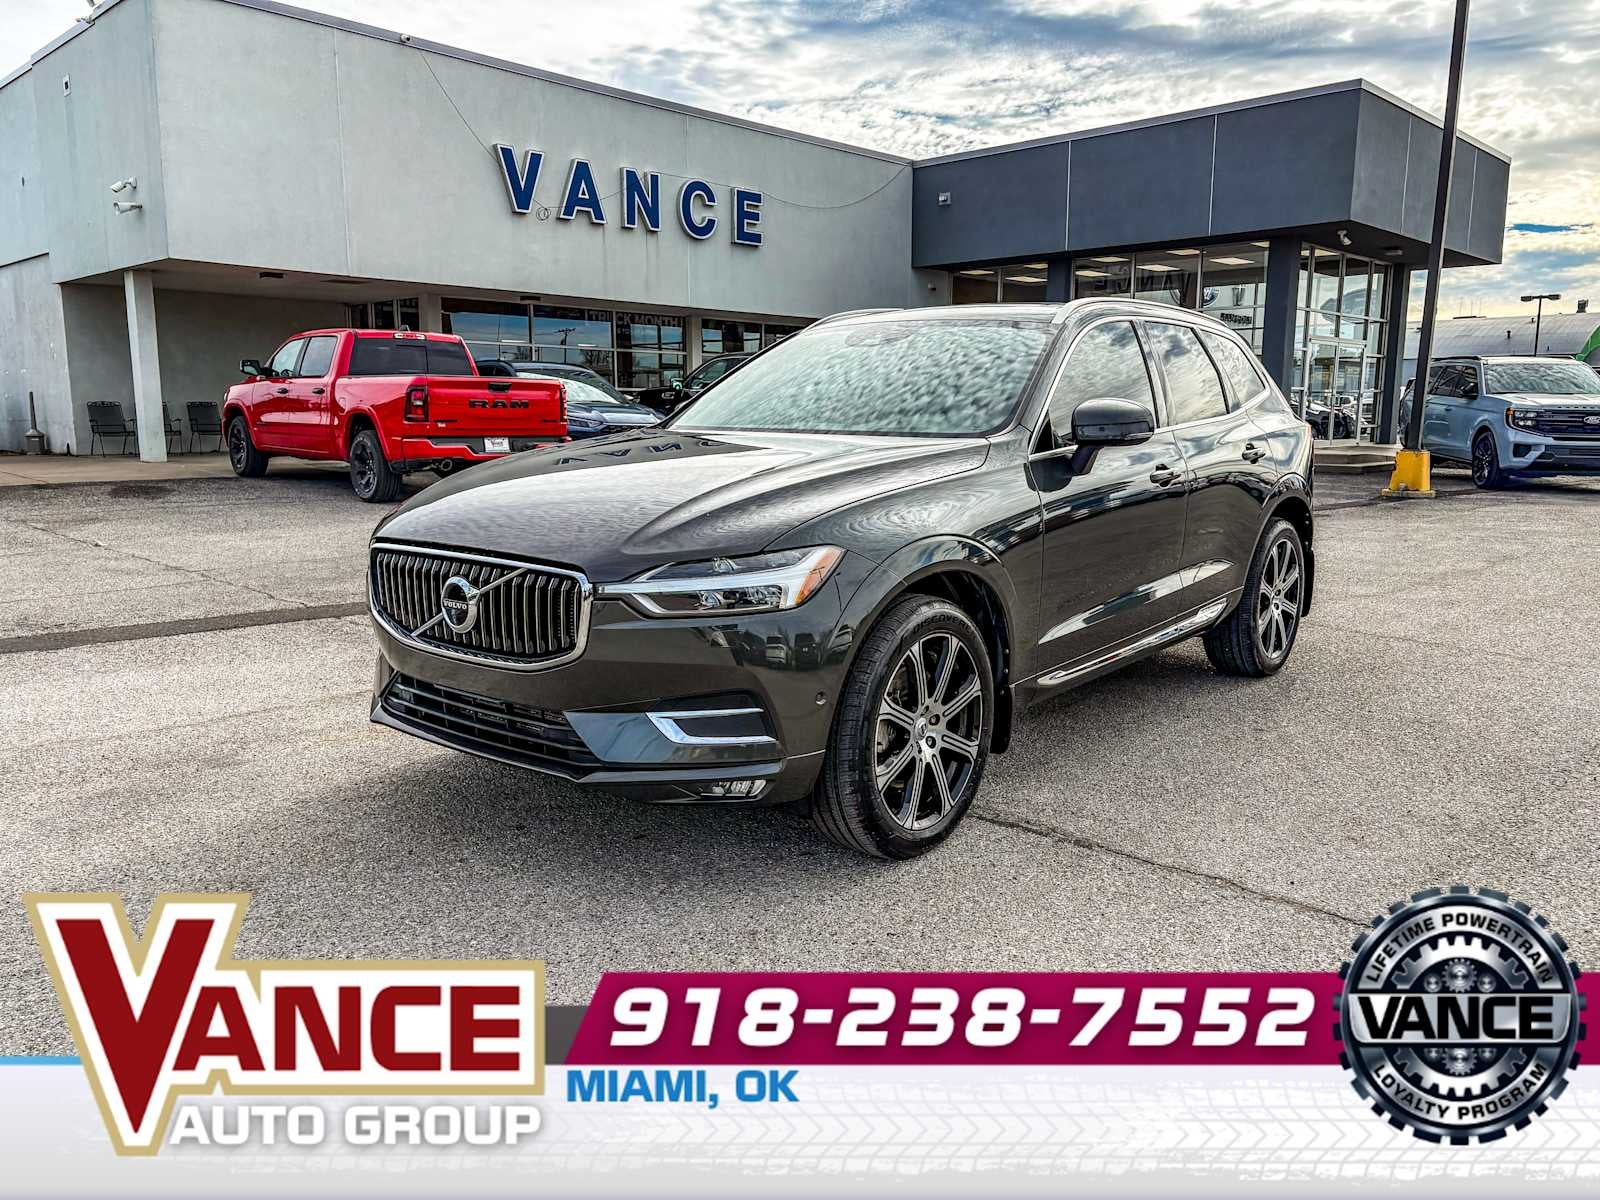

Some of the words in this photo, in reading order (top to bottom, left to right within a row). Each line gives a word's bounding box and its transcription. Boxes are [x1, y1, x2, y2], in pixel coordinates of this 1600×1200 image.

[494, 143, 763, 247] VANCE
[468, 399, 529, 409] RAM
[443, 600, 467, 610] VOLVO
